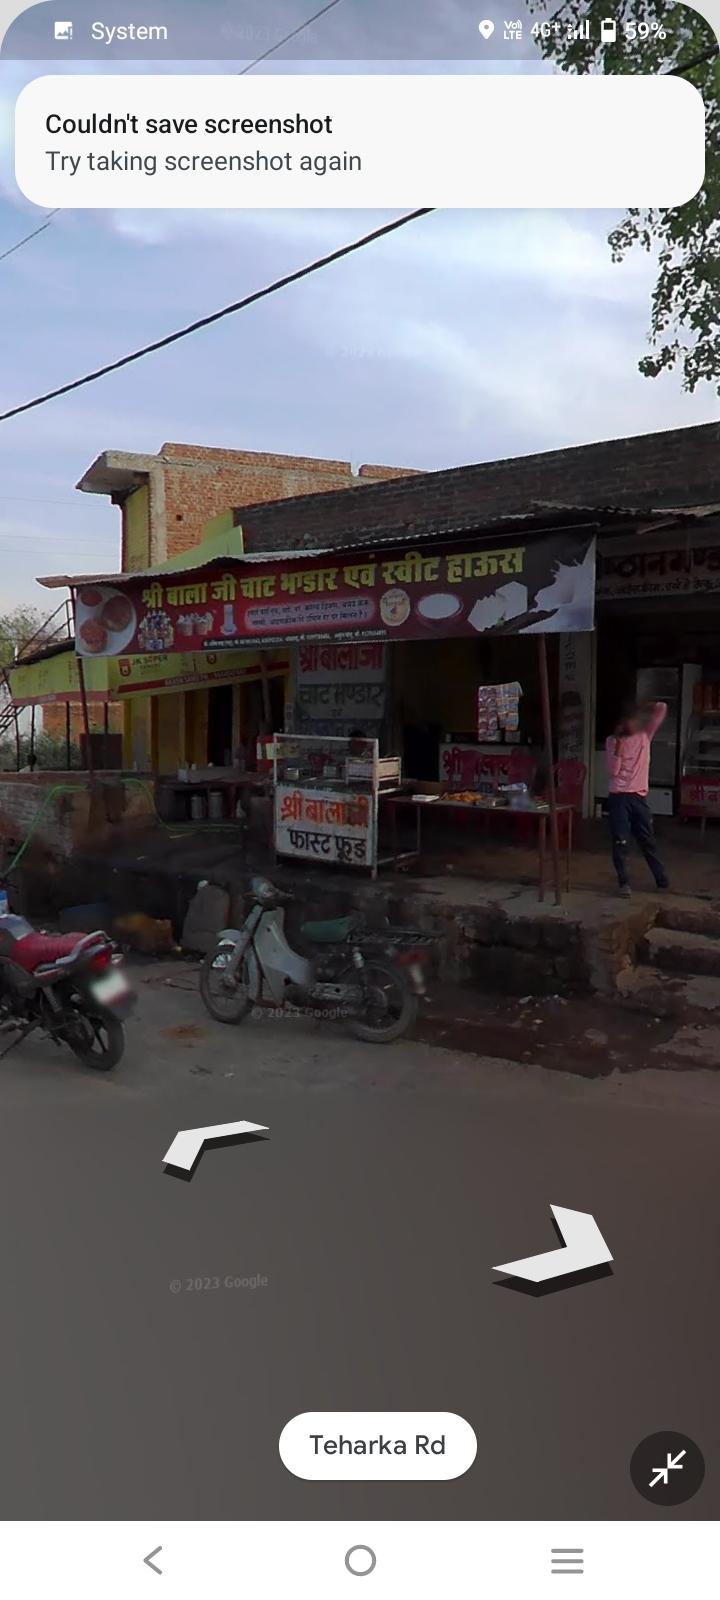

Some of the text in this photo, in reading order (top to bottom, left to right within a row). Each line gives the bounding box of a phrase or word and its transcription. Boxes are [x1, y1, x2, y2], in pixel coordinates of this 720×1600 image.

[142, 582, 164, 609] श्री
[166, 583, 208, 606] बाला
[240, 575, 277, 598] चाट
[382, 551, 441, 585] स्वीट
[281, 790, 304, 823] श्री
[287, 828, 331, 854] फास्ट
